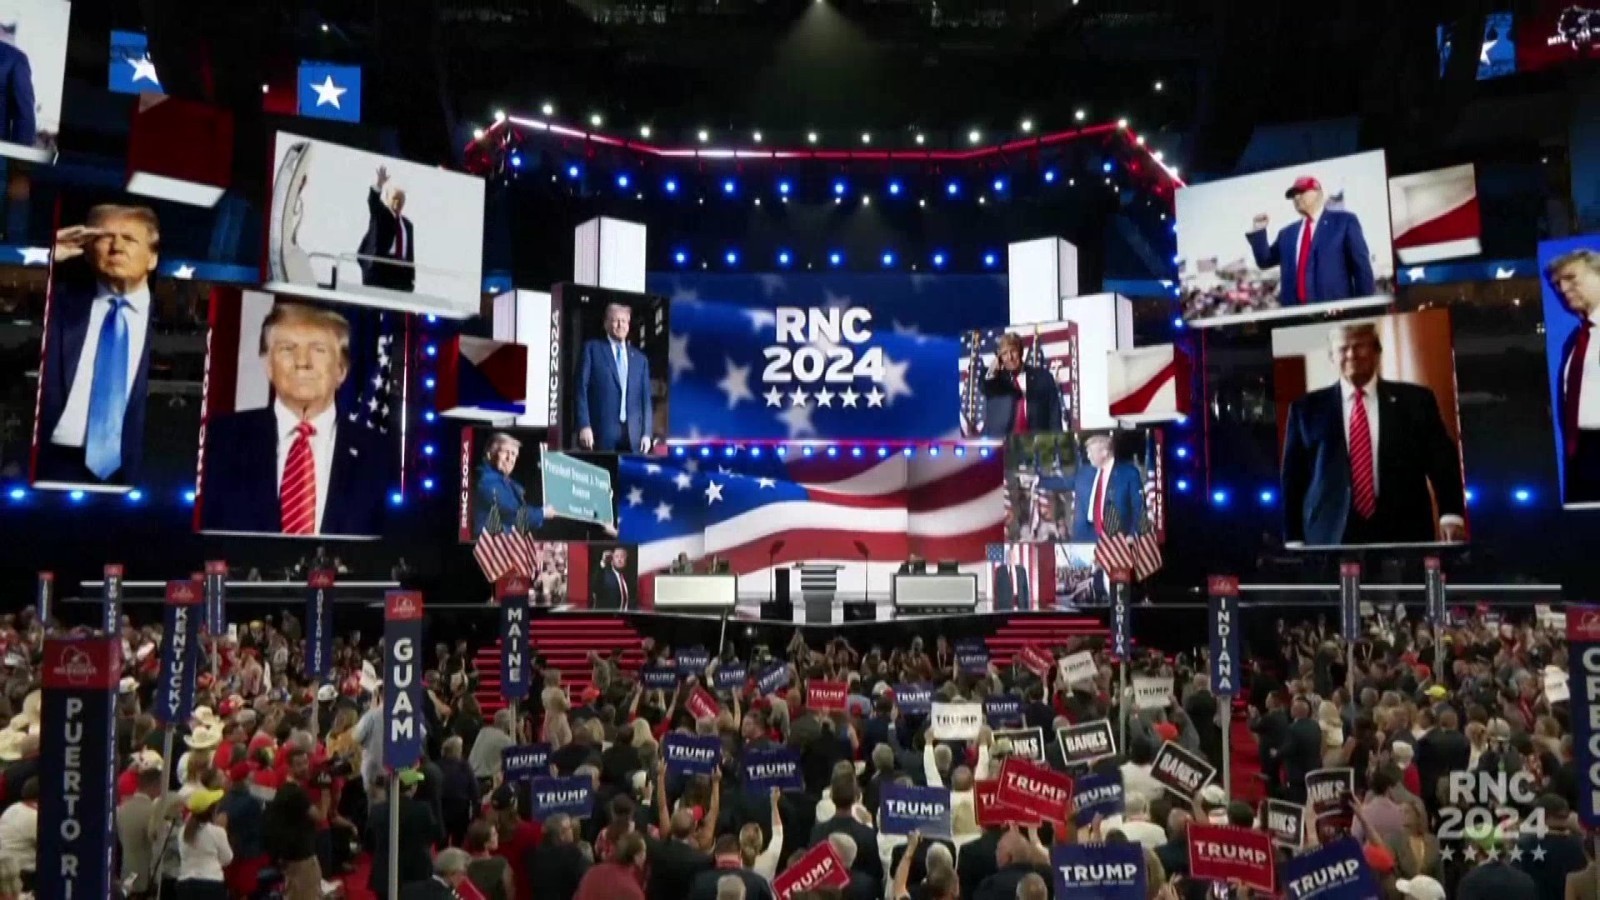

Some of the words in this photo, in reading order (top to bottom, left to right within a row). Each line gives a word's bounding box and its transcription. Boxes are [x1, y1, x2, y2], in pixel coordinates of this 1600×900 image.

[775, 307, 872, 343] RNC
[763, 347, 885, 382] 2024
[1115, 583, 1125, 654] FLORIDA
[507, 608, 523, 683] MAINE
[1217, 597, 1232, 690] INDIANA
[168, 607, 188, 716] KENTUCKY
[679, 656, 708, 667] TRUMP
[644, 673, 676, 682] TRUMP
[391, 637, 414, 743] GUAM
[810, 689, 845, 699] TRUMP
[896, 692, 931, 702] TRUMP
[986, 703, 1019, 713] TRUMP
[936, 714, 978, 726] TRUMP
[667, 744, 716, 759] TRUMP
[1013, 738, 1039, 757] NKS
[1065, 731, 1108, 753] BANKS
[60, 698, 83, 841] PUERTO
[506, 753, 547, 767] TRUMP
[747, 762, 796, 777] TRUMP
[1159, 752, 1203, 788] BANKS
[536, 789, 588, 803] TRUMP
[1007, 772, 1067, 801] TRUMP
[1073, 784, 1122, 806] TRUMP
[886, 800, 945, 816] TRUMP
[1194, 840, 1267, 864] TRUMP
[782, 857, 833, 899] TRUMP
[1059, 863, 1137, 881] TRUMP
[1289, 859, 1359, 897] TRUMP
